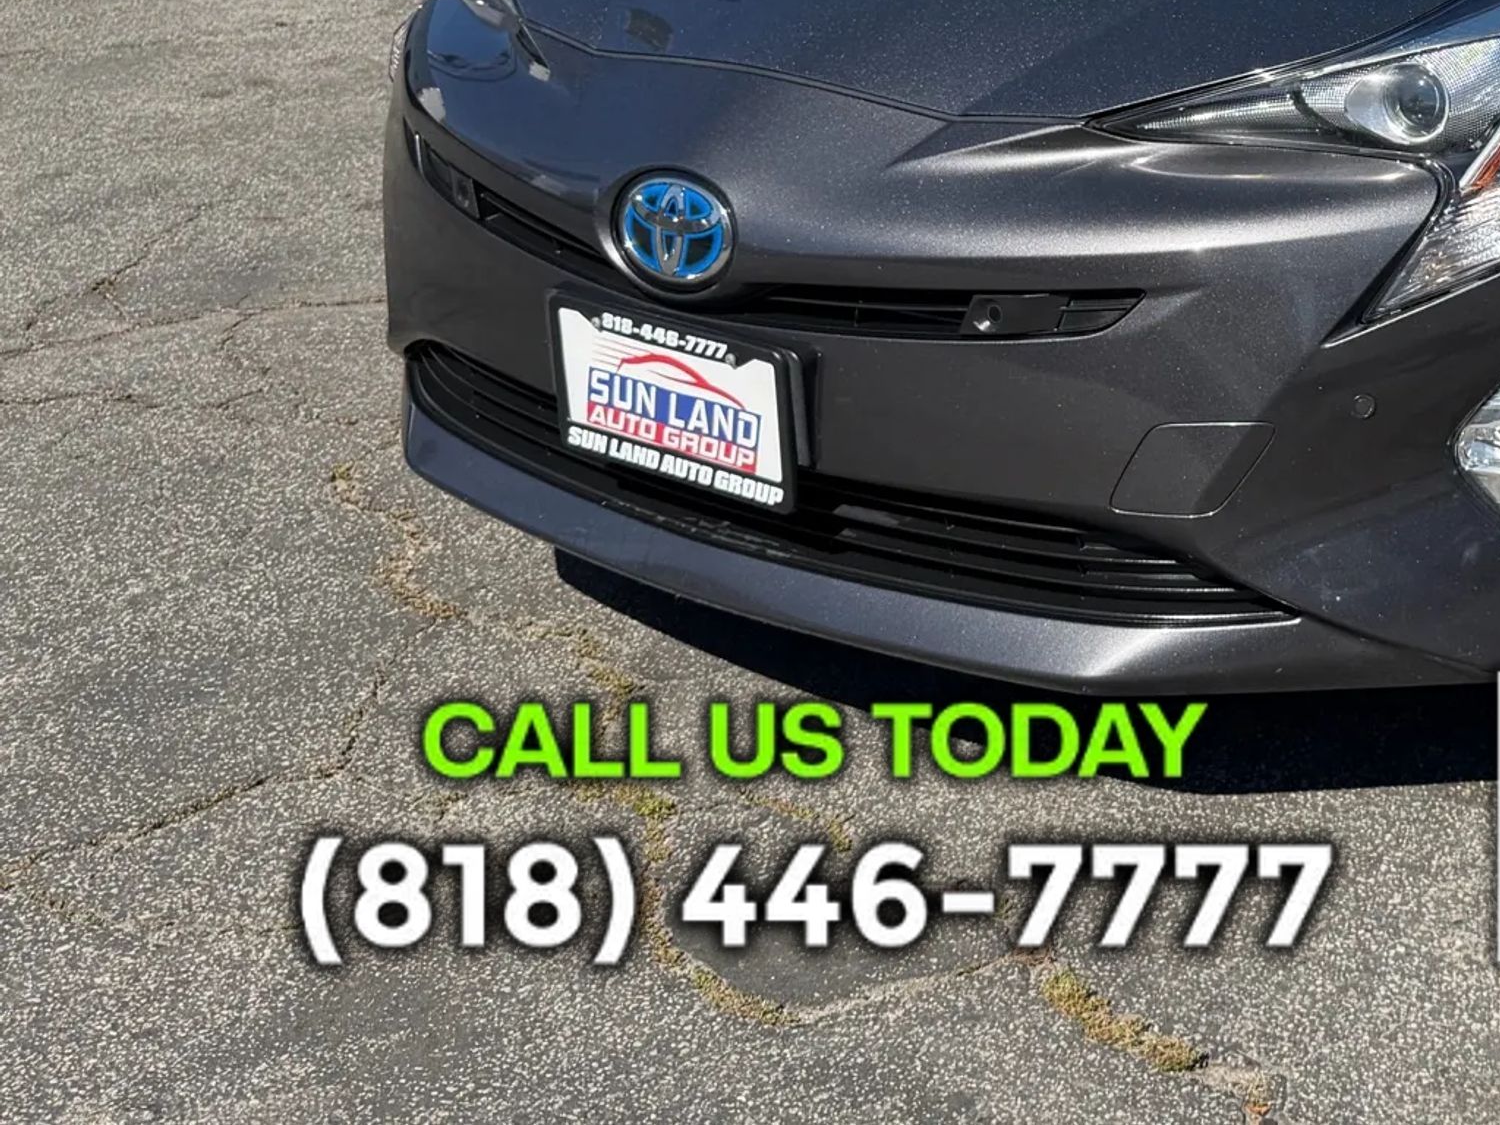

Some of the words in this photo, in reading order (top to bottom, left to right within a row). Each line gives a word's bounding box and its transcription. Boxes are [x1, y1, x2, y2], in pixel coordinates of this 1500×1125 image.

[601, 312, 729, 360] 818-446-7777
[588, 368, 657, 419] SUN
[666, 391, 760, 450] LAND
[589, 405, 657, 442] AUTO
[661, 426, 758, 471] GROUP
[567, 426, 608, 455] SUN
[608, 438, 660, 472] LAND
[658, 453, 713, 487] AUTO
[712, 470, 785, 507] GROUP
